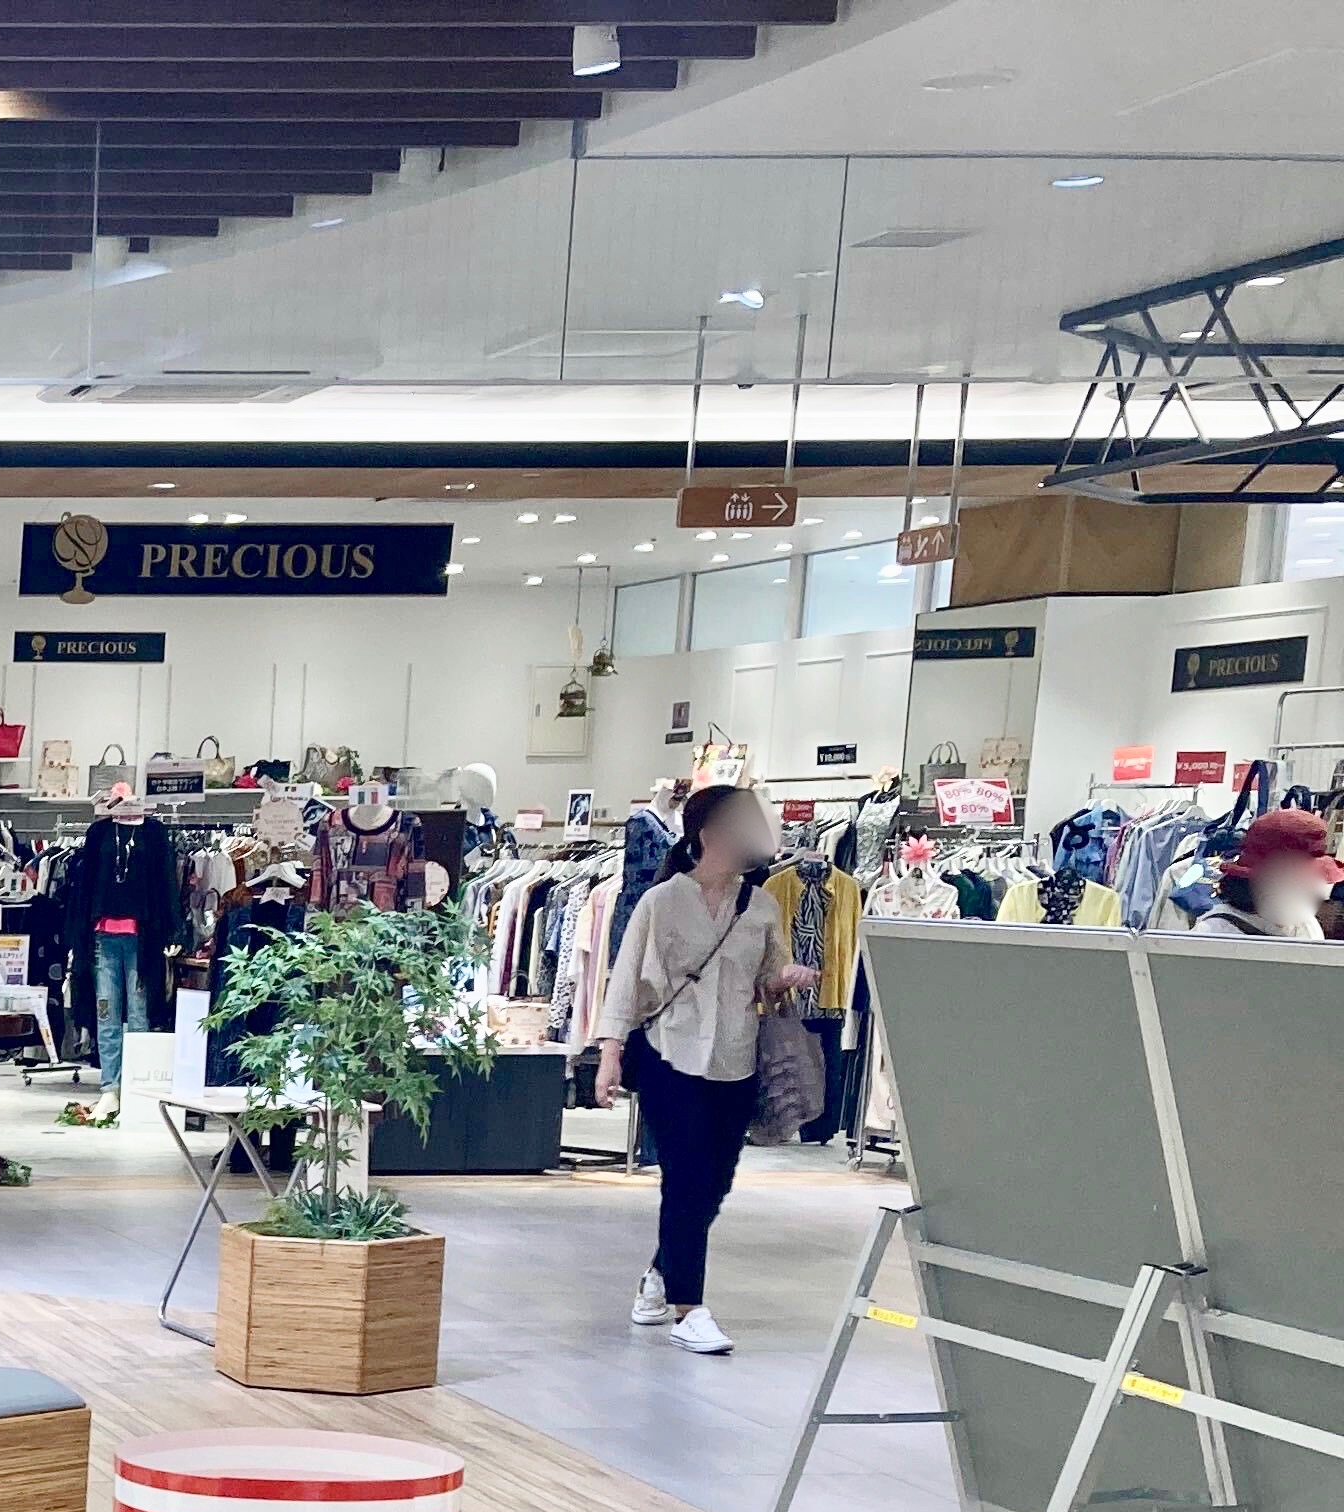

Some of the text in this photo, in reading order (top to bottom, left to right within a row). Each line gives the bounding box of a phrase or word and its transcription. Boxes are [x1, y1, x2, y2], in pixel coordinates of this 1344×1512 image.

[138, 542, 376, 579] PRECIOUS
[56, 641, 137, 655] PRECIOUS
[1207, 653, 1280, 677] PRECIOUS
[944, 786, 973, 799] 80%
[976, 786, 1006, 804] 80%
